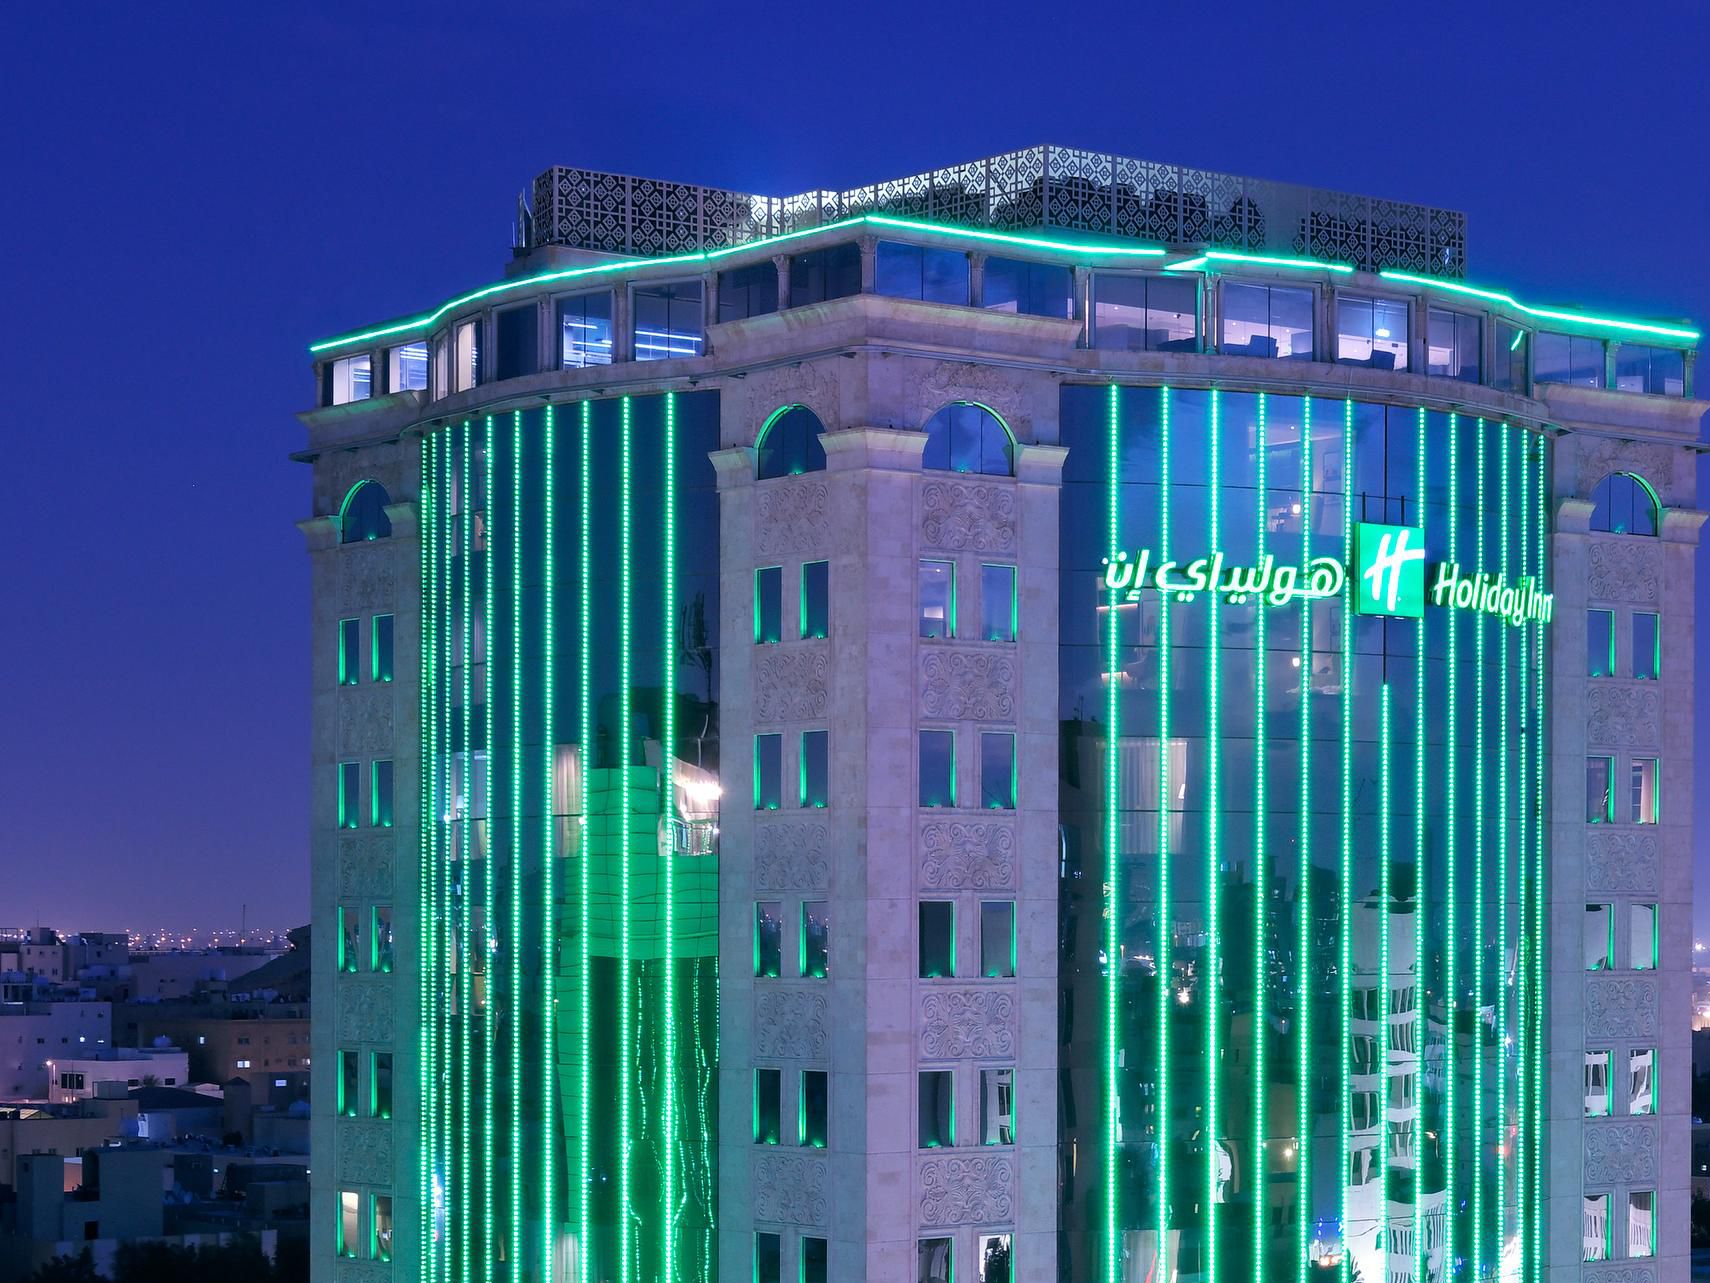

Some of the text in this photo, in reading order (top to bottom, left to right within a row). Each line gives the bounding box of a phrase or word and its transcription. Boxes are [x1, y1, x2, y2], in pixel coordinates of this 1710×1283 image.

[1156, 551, 1344, 606] هوليداي
[1434, 561, 1554, 627] Holiday Inn
